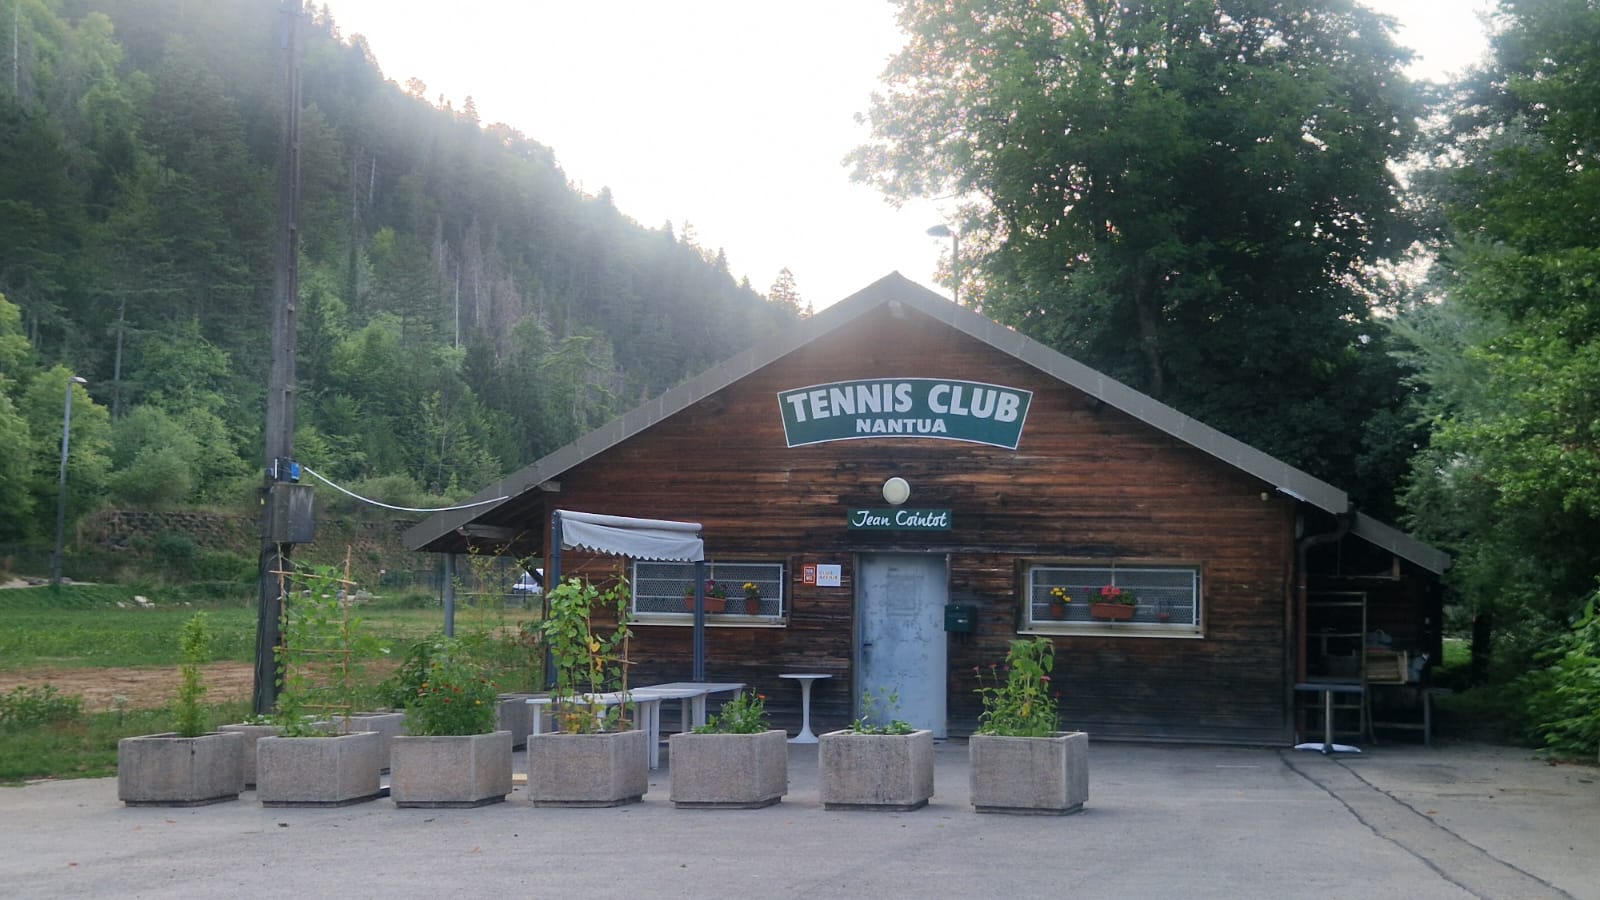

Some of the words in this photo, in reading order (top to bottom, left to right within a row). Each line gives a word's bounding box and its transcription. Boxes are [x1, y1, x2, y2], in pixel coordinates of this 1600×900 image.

[786, 383, 913, 422] TENNIS
[927, 384, 1020, 422] CLUB
[855, 418, 947, 434] NANTUA
[852, 510, 890, 527] Jean
[895, 510, 947, 527] Cointot
